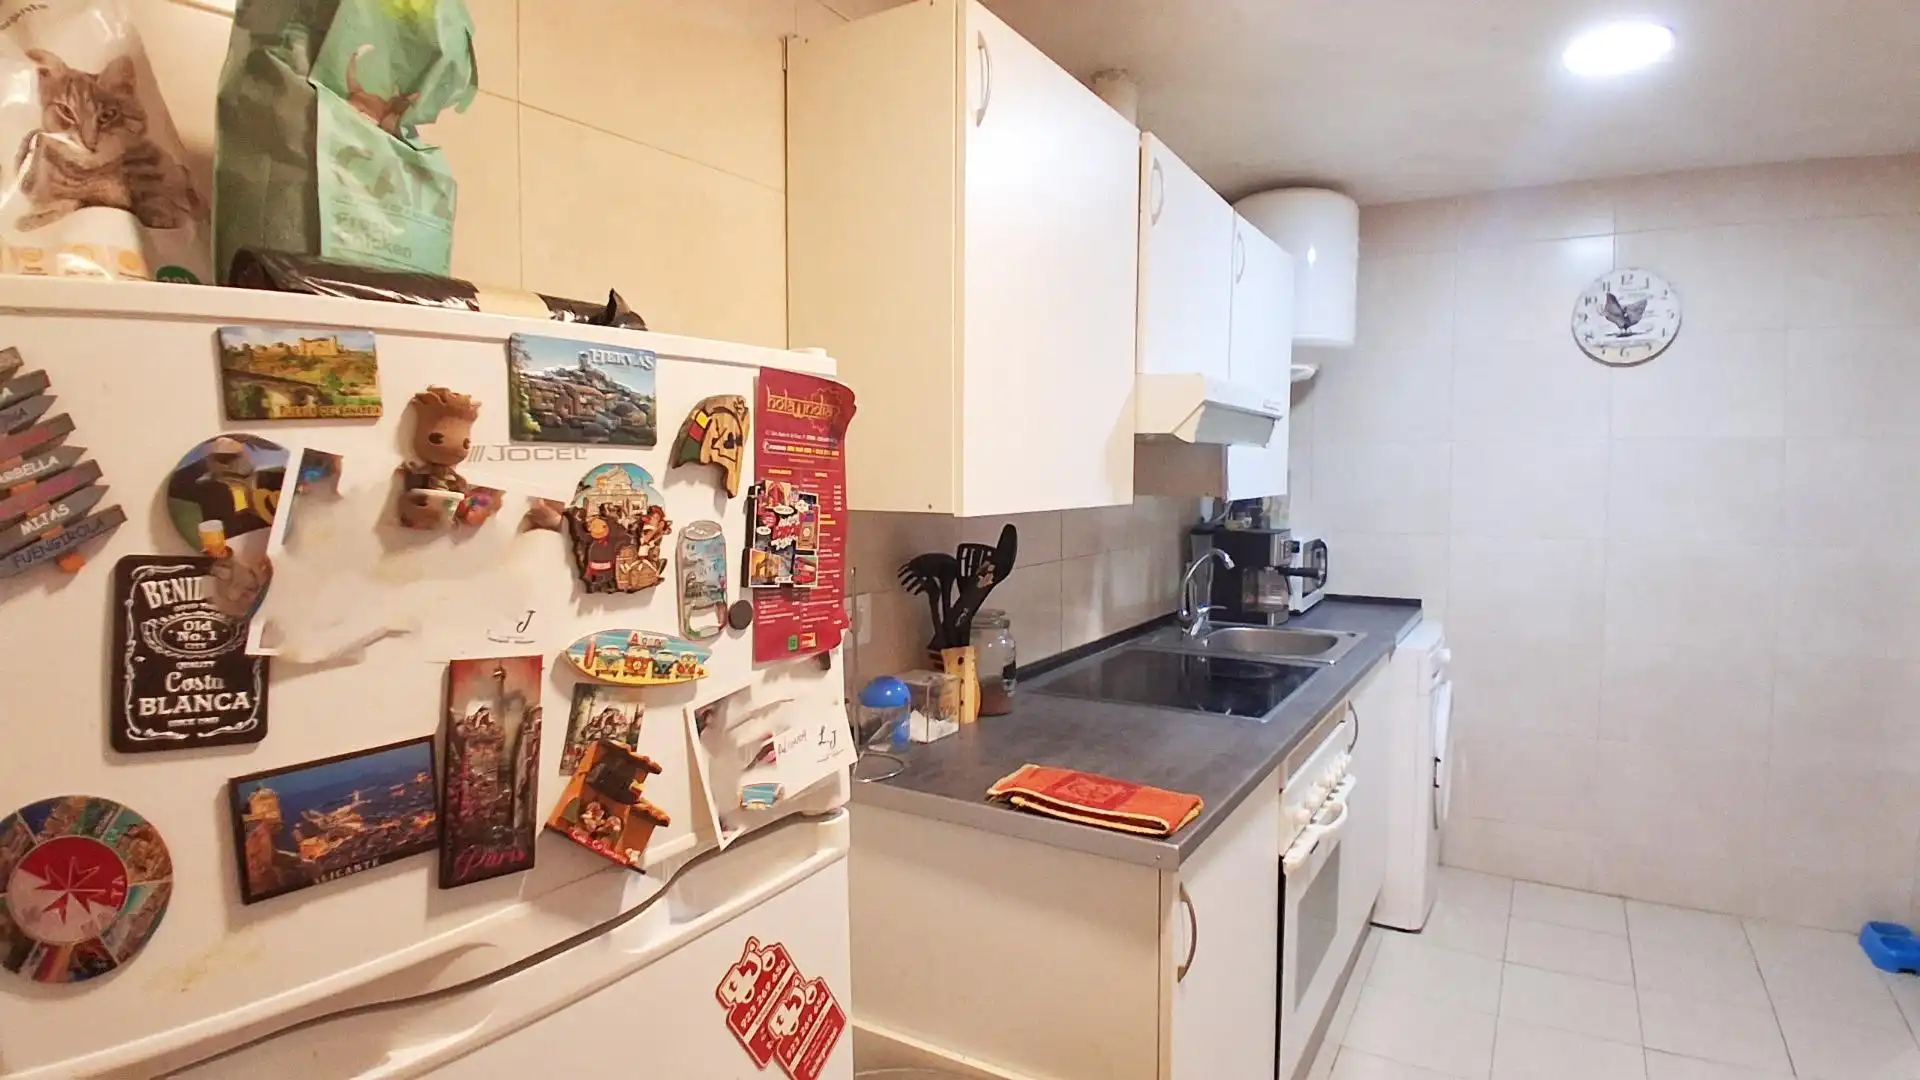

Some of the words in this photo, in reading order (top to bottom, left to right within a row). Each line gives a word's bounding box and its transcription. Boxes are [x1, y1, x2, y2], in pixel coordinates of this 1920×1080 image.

[20, 503, 71, 536] MIJAS
[183, 620, 213, 631] Old
[177, 631, 205, 642] No.
[138, 691, 252, 716] BLANCA
